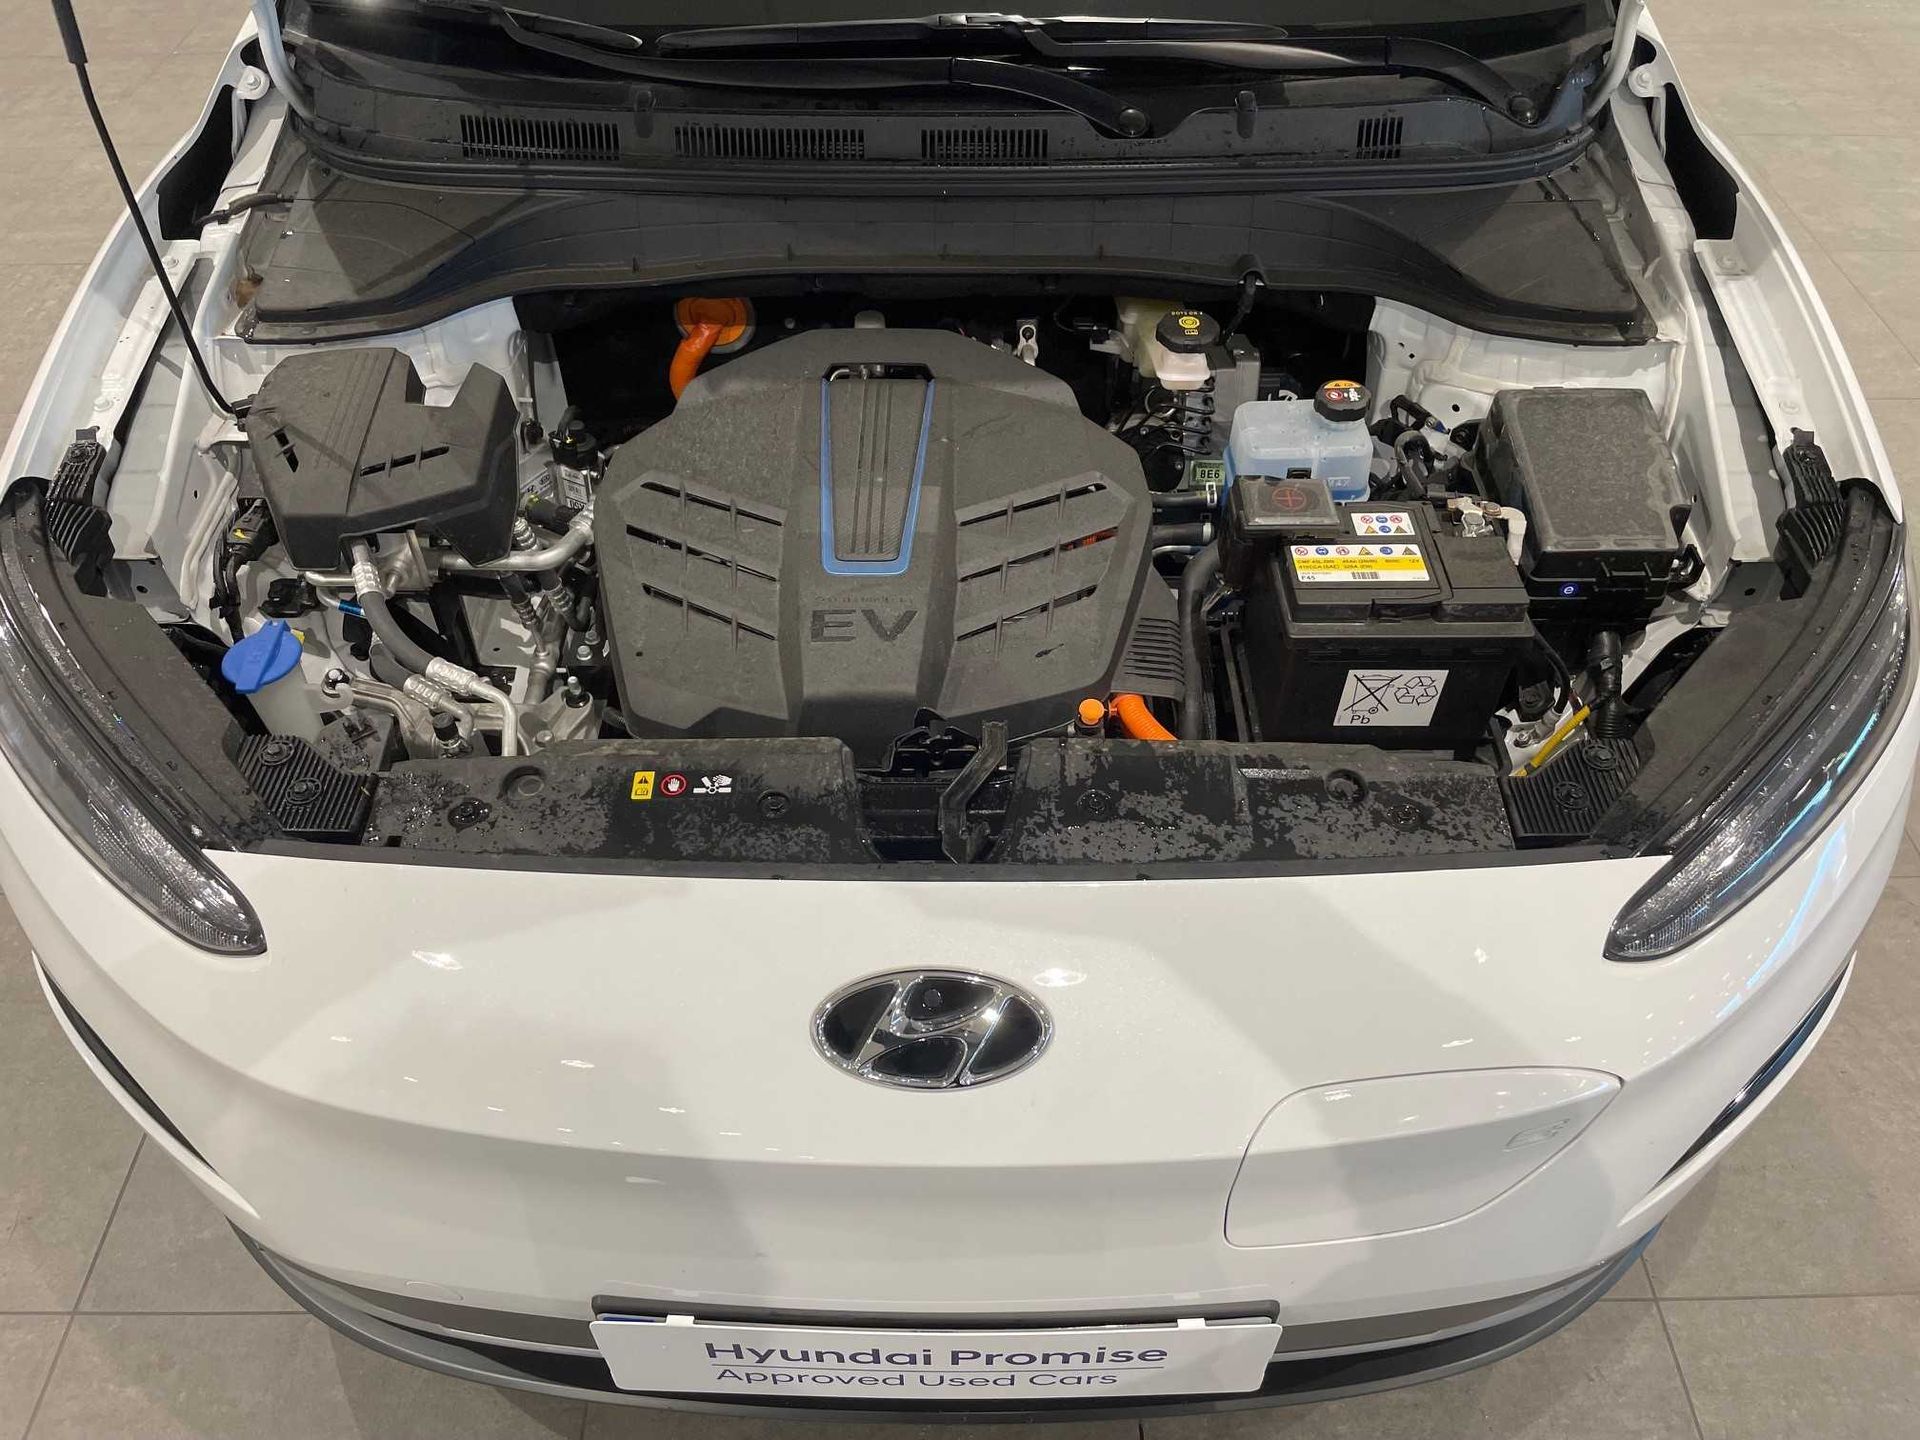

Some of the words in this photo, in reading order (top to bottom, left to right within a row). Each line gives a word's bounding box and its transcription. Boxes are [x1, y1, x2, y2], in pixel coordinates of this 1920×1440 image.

[811, 609, 918, 642] EV
[1350, 714, 1370, 724] Pb
[705, 1342, 931, 1365] Hyundai
[950, 1346, 1168, 1366] Promise
[717, 1369, 905, 1386] Approved
[919, 1374, 1015, 1387] Used
[1029, 1373, 1118, 1386] Cars
